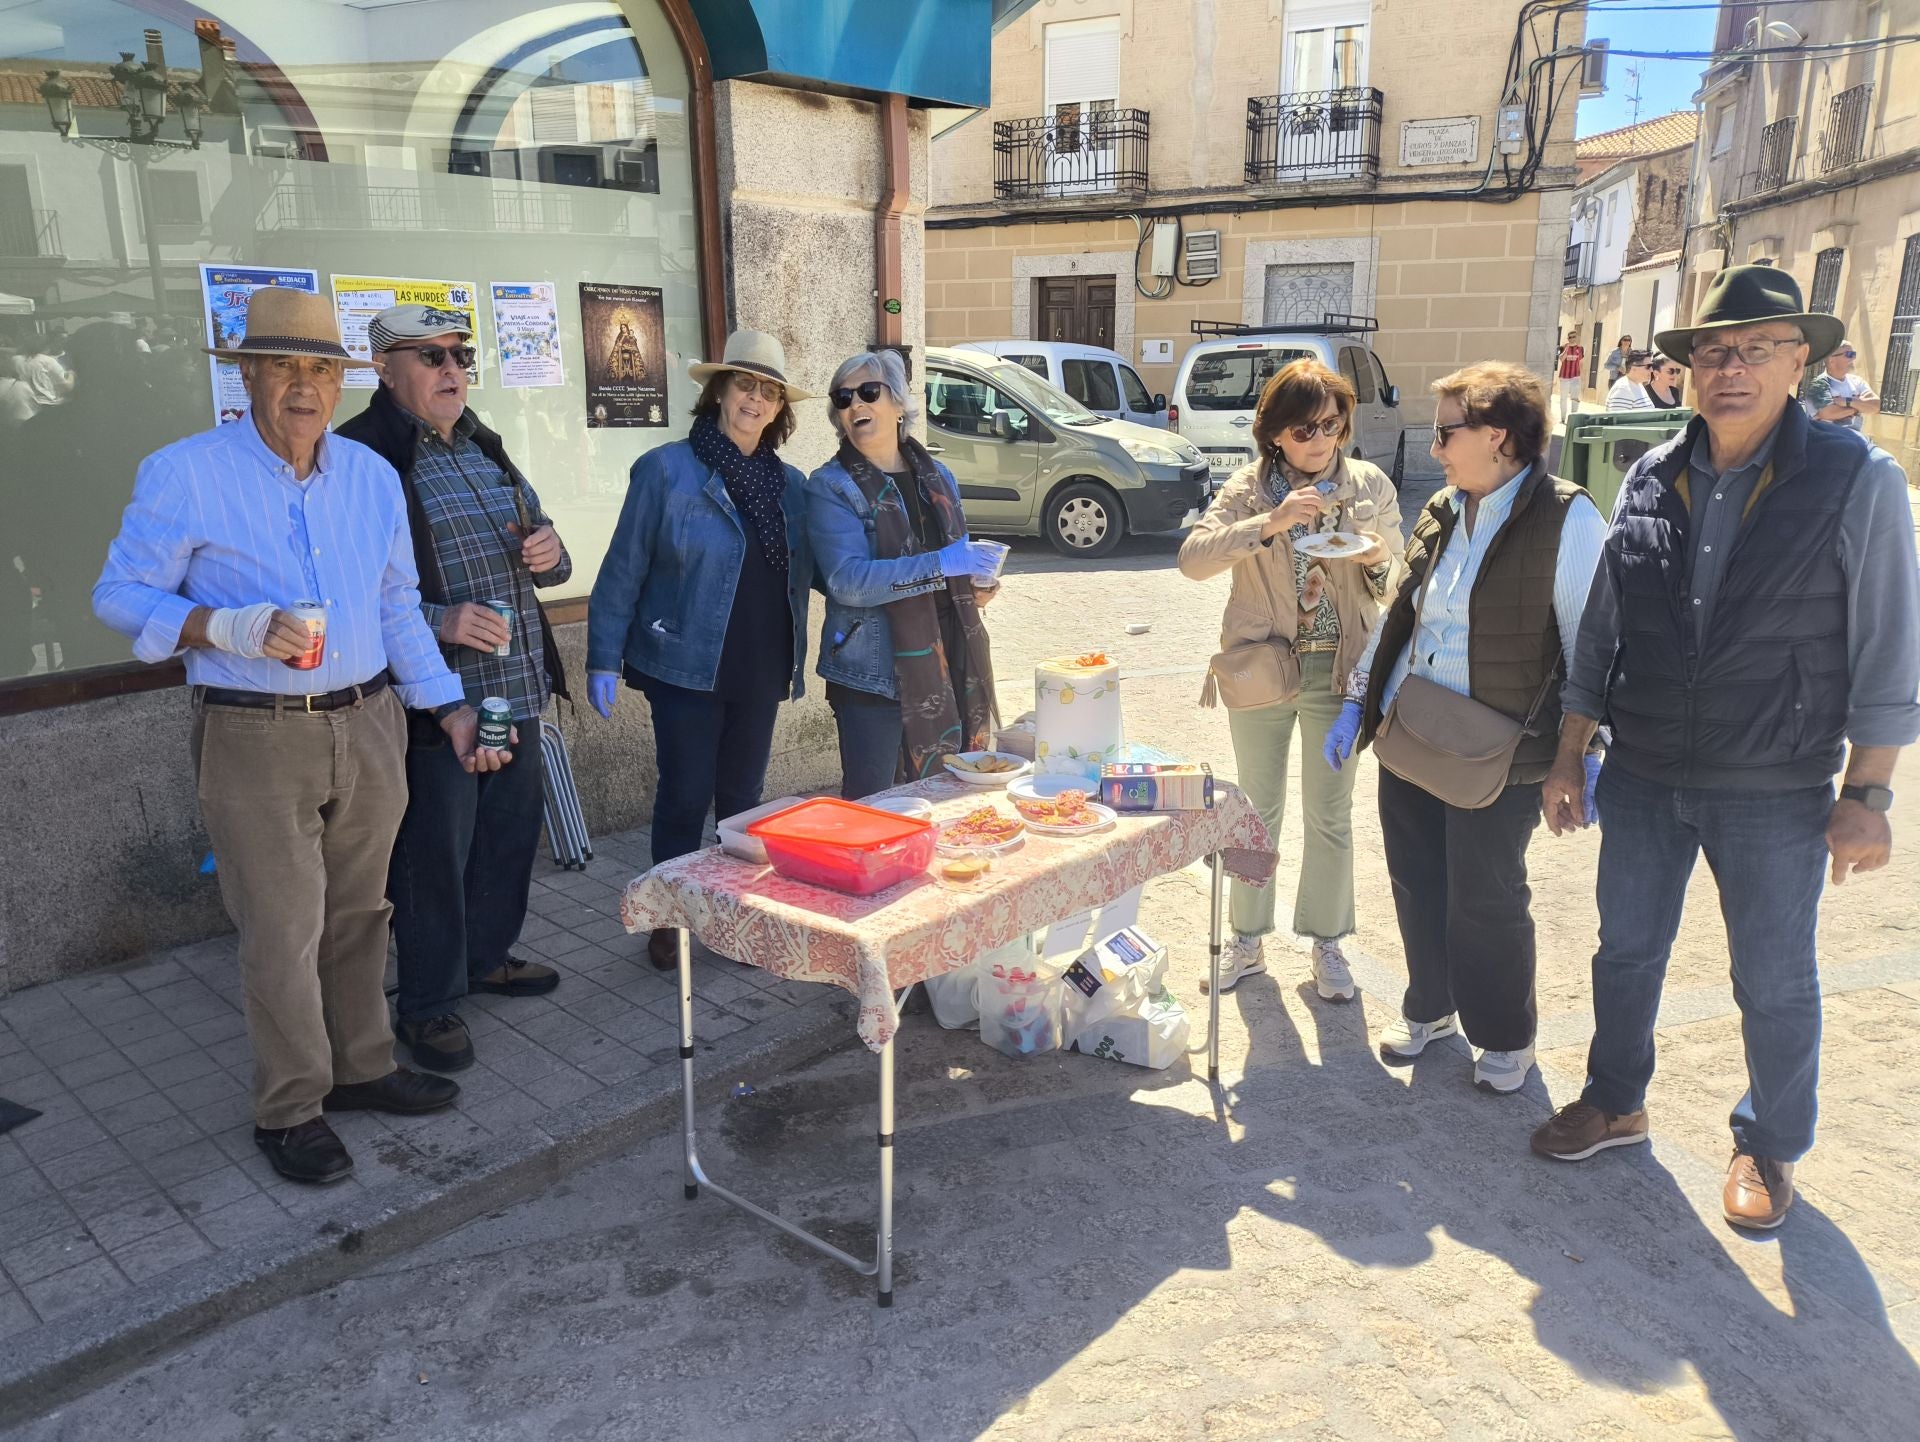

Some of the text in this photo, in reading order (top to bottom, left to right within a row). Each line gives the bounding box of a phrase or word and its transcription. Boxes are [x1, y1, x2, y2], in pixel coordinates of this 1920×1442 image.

[1428, 128, 1449, 136] PLAZA
[278, 276, 306, 284] SEDIACO
[395, 291, 446, 303] LAS HURDES
[450, 289, 468, 304] 16€
[479, 730, 507, 741] Mahou
